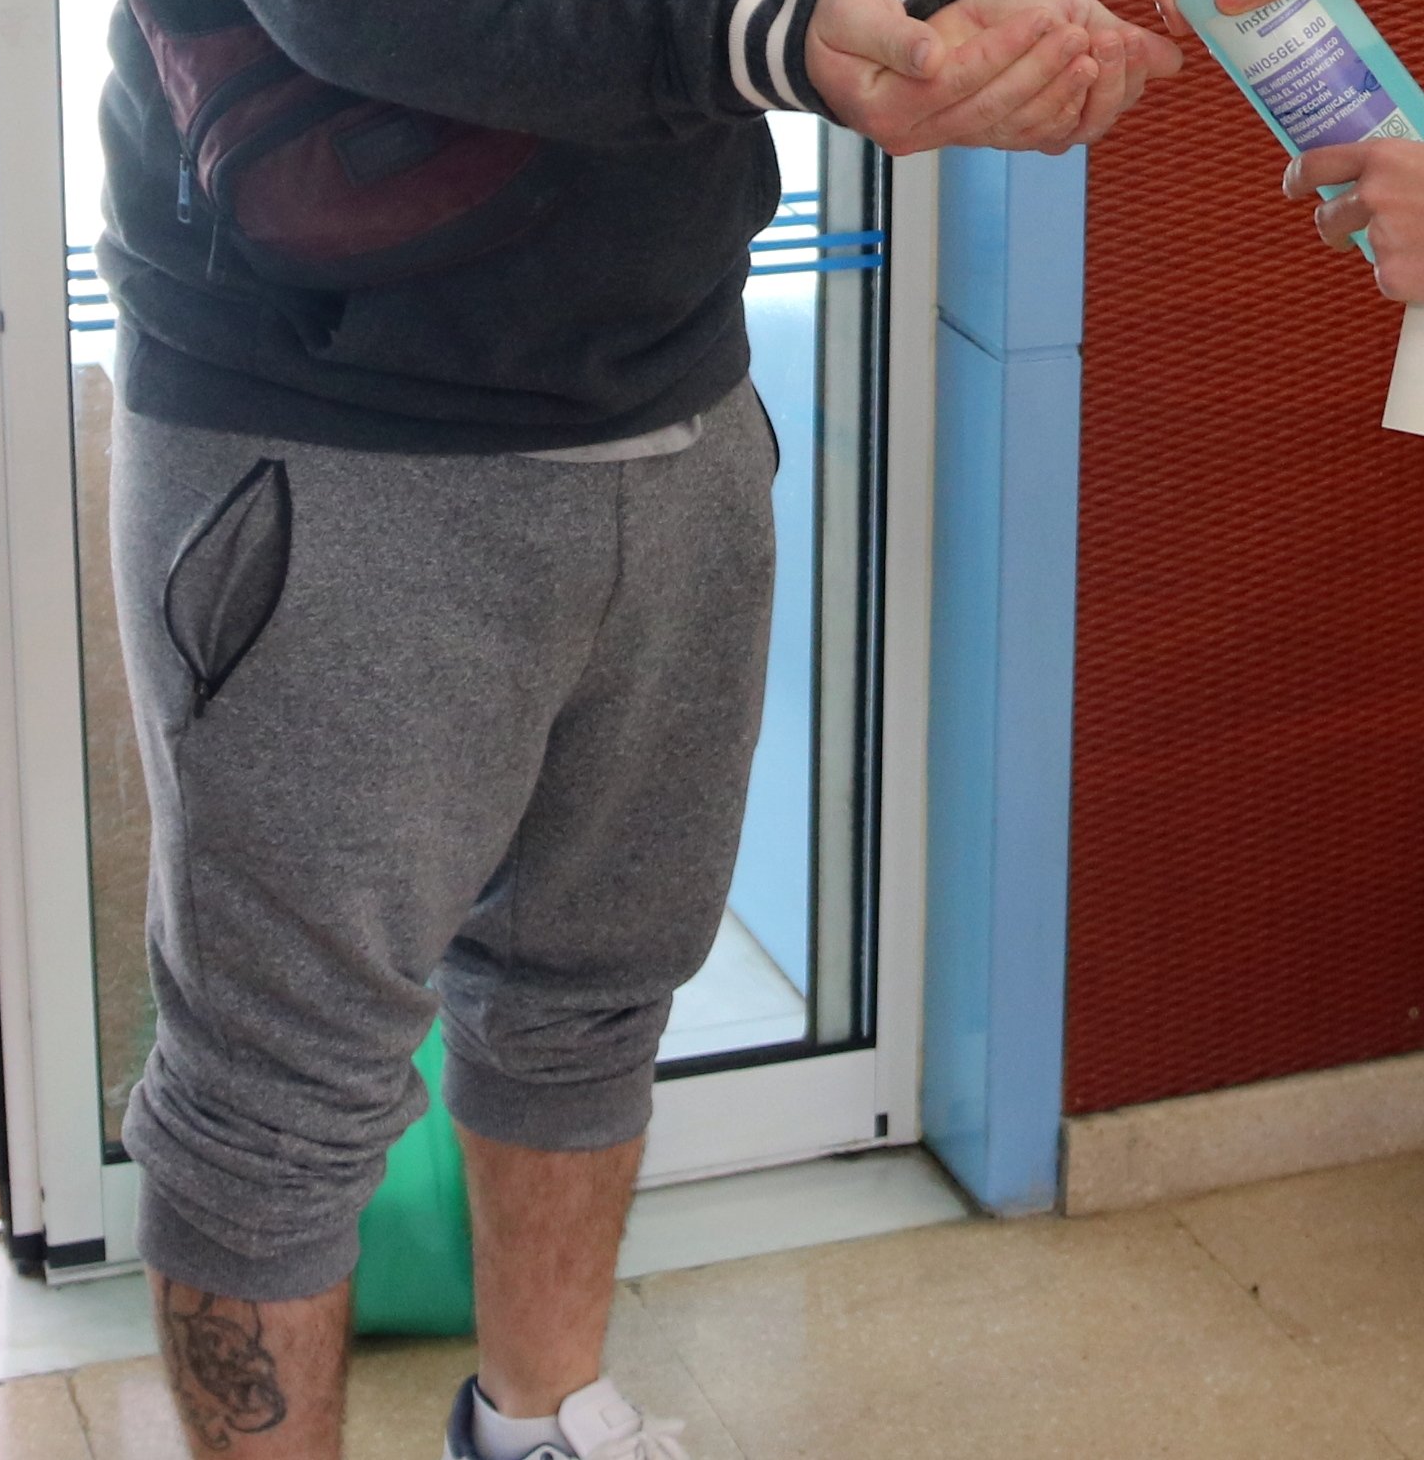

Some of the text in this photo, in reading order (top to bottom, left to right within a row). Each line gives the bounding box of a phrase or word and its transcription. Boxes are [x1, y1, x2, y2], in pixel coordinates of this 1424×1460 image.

[1243, 16, 1326, 80] ANIOSGEL 800
[1282, 87, 1294, 97] EL
[1292, 47, 1345, 90] TRATAMIENTO
[1312, 80, 1326, 92] LA
[1343, 85, 1357, 100] DE
[1318, 117, 1337, 133] POR
